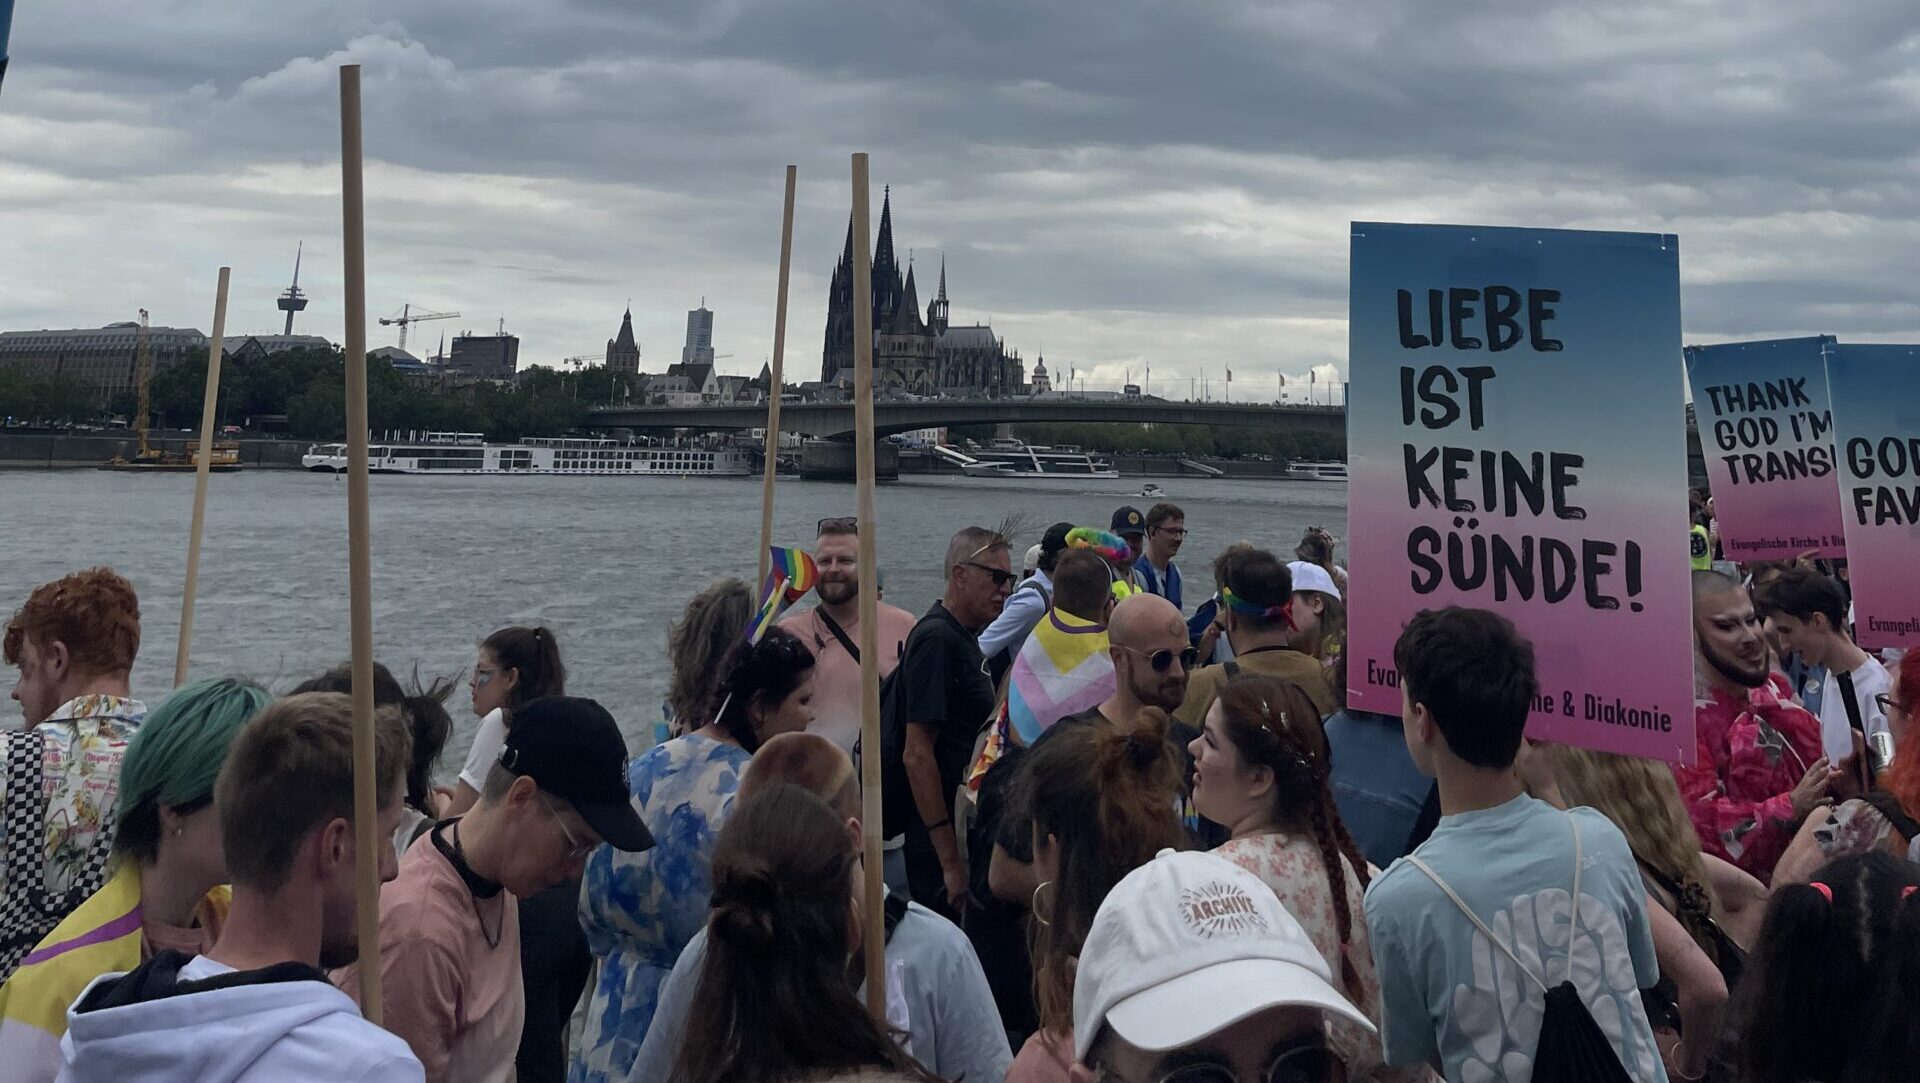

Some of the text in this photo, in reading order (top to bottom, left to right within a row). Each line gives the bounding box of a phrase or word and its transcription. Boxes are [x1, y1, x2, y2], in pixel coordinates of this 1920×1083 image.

[1397, 286, 1564, 352] LIEBE
[1401, 365, 1496, 430] IST
[1705, 376, 1811, 416] THANK
[1714, 410, 1833, 451] GOD I'M
[1403, 443, 1587, 520] KEINE
[1853, 486, 1920, 526] FAV
[1731, 538, 1788, 552] Evangelische
[1790, 536, 1820, 549] Kirche
[1822, 535, 1829, 547] &
[1407, 517, 1644, 613] SÜNDE!
[1868, 616, 1920, 636] Evangeli
[1368, 658, 1401, 688] Eva
[1563, 690, 1575, 717] &
[1585, 693, 1672, 732] Diakonie
[1192, 896, 1258, 920] ARCHIVE
